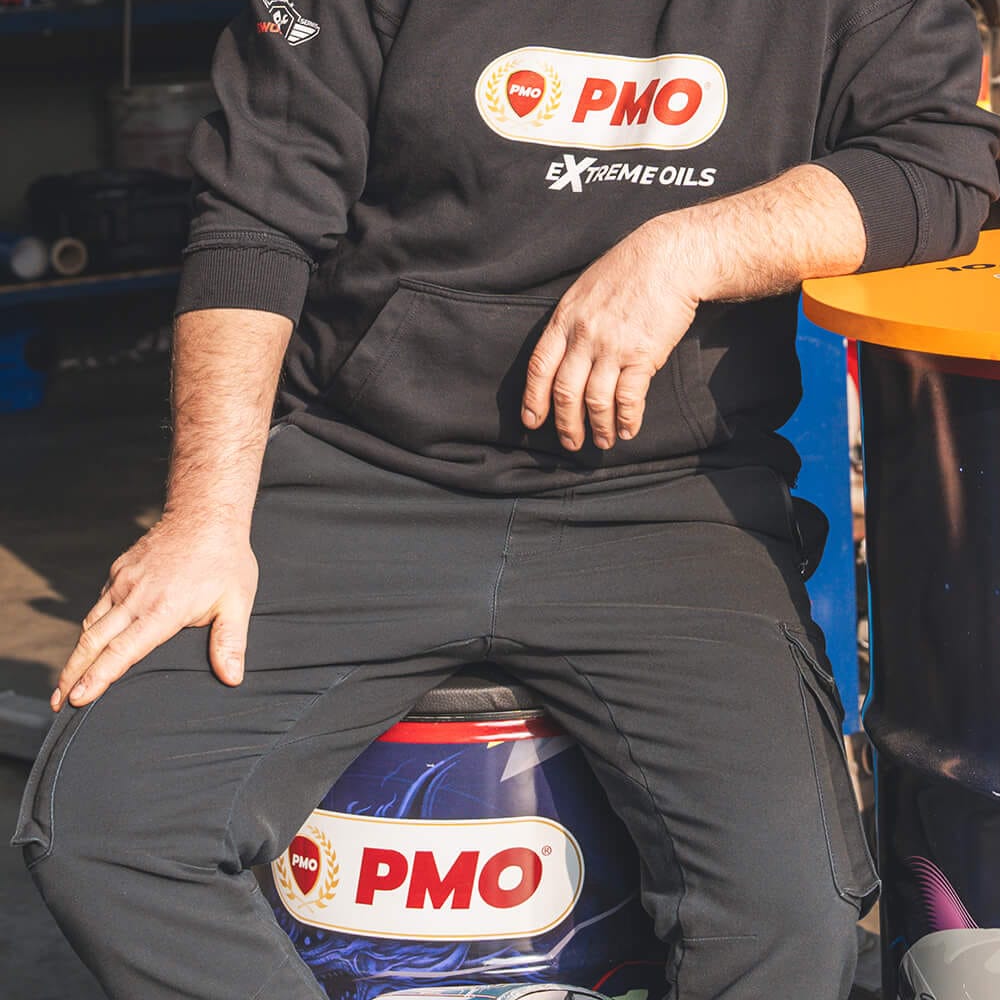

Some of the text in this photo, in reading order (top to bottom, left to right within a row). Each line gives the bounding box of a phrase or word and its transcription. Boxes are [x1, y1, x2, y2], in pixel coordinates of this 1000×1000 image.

[509, 83, 541, 99] PMO
[572, 77, 703, 126] PMO
[659, 165, 718, 187] OILS
[292, 855, 317, 872] PMO
